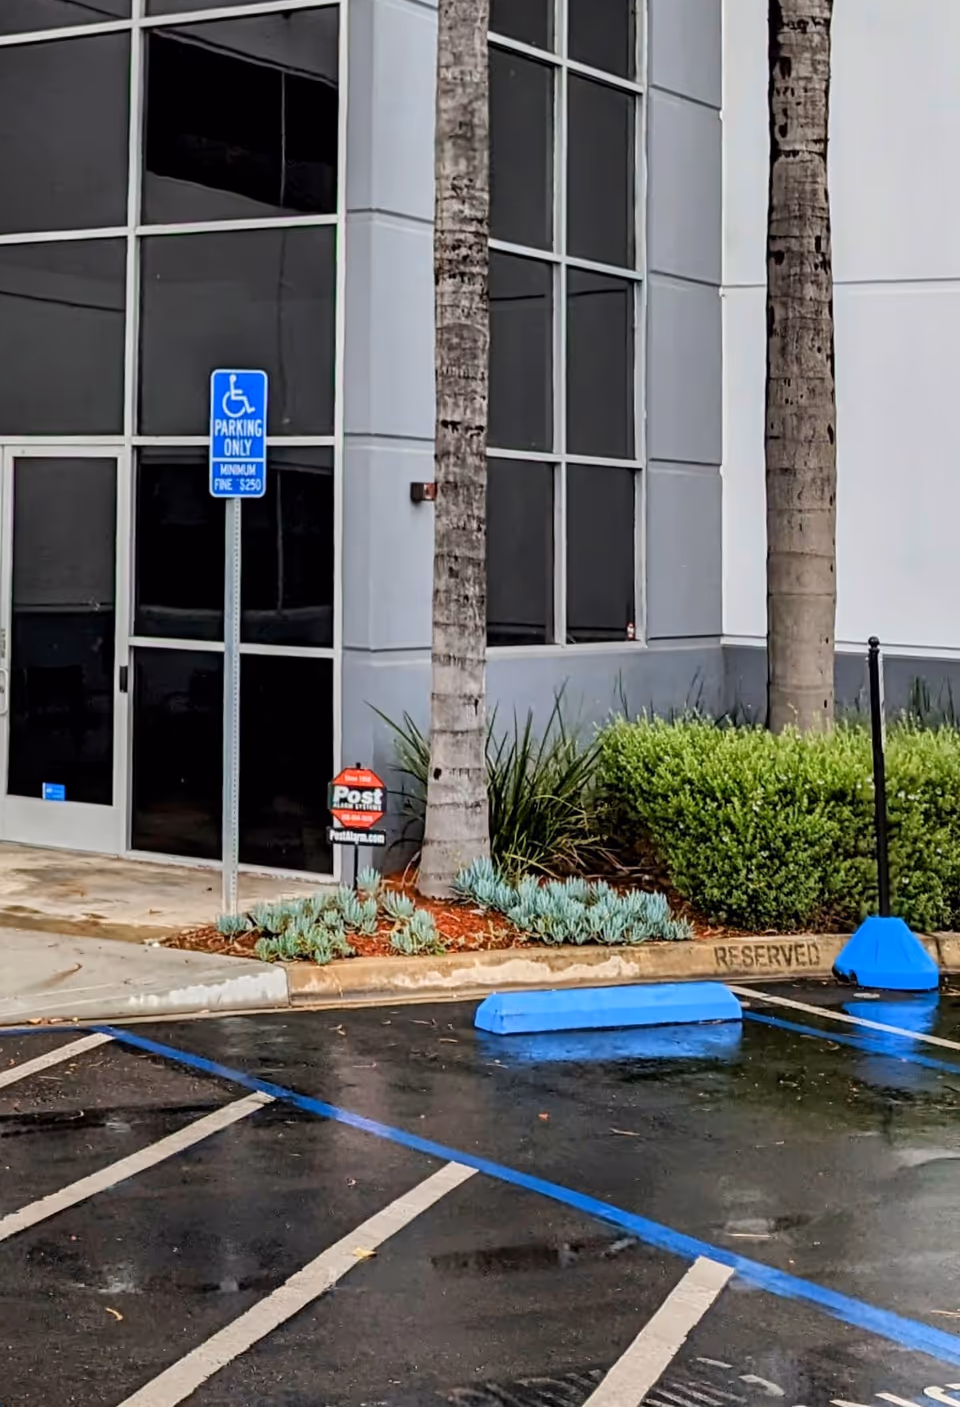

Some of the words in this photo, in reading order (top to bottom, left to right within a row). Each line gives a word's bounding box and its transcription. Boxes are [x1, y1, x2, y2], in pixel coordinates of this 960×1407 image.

[214, 419, 262, 437] PARKING
[224, 438, 252, 456] ONLY
[220, 464, 256, 476] MINIMUM
[214, 478, 233, 491] FINE
[239, 478, 261, 491] $250
[333, 785, 383, 804] Post
[714, 942, 821, 967] RESERVED
